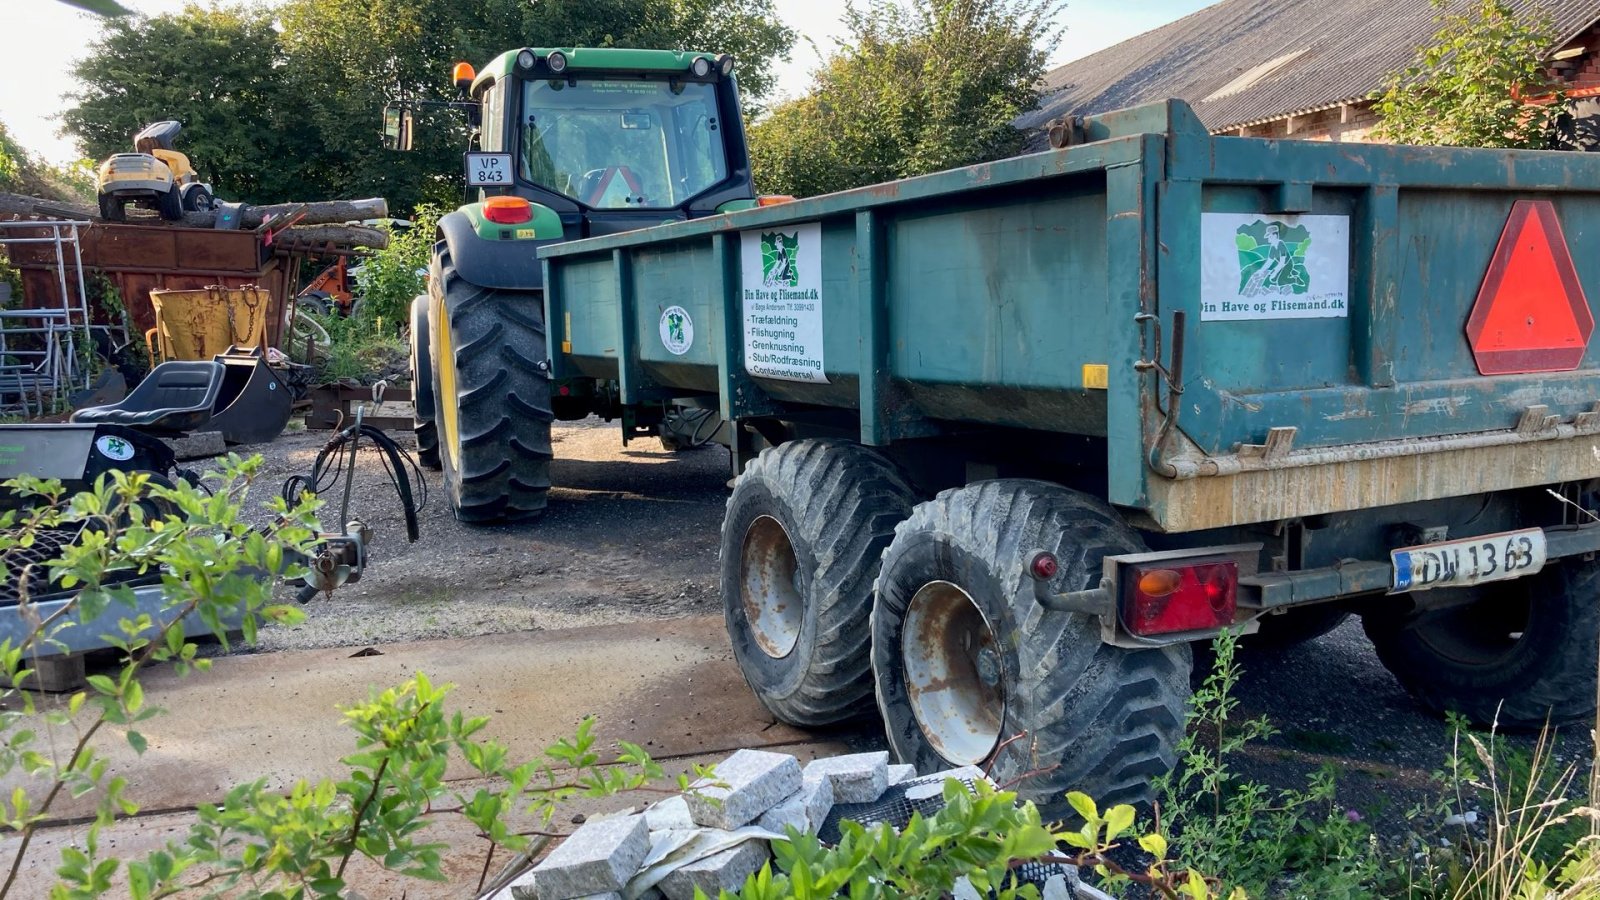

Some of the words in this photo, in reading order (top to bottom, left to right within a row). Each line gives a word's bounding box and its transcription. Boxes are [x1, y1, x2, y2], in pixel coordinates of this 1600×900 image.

[481, 158, 499, 169] VP
[478, 170, 503, 182] 843
[744, 289, 754, 300] Din
[755, 289, 769, 300] Have
[770, 292, 778, 302] og
[779, 288, 819, 300] Flisemand.dk
[1222, 301, 1249, 312] Have
[1254, 302, 1266, 313] og
[1271, 299, 1345, 311] Flisemand.dk
[751, 315, 798, 328] Træfældning
[751, 328, 795, 340] Flishugning
[752, 340, 805, 355] Grenknusning
[752, 353, 821, 370] Stub/Rodfræsning
[1421, 549, 1460, 585] DW
[1468, 542, 1498, 579] 13
[1504, 536, 1533, 573] 63
